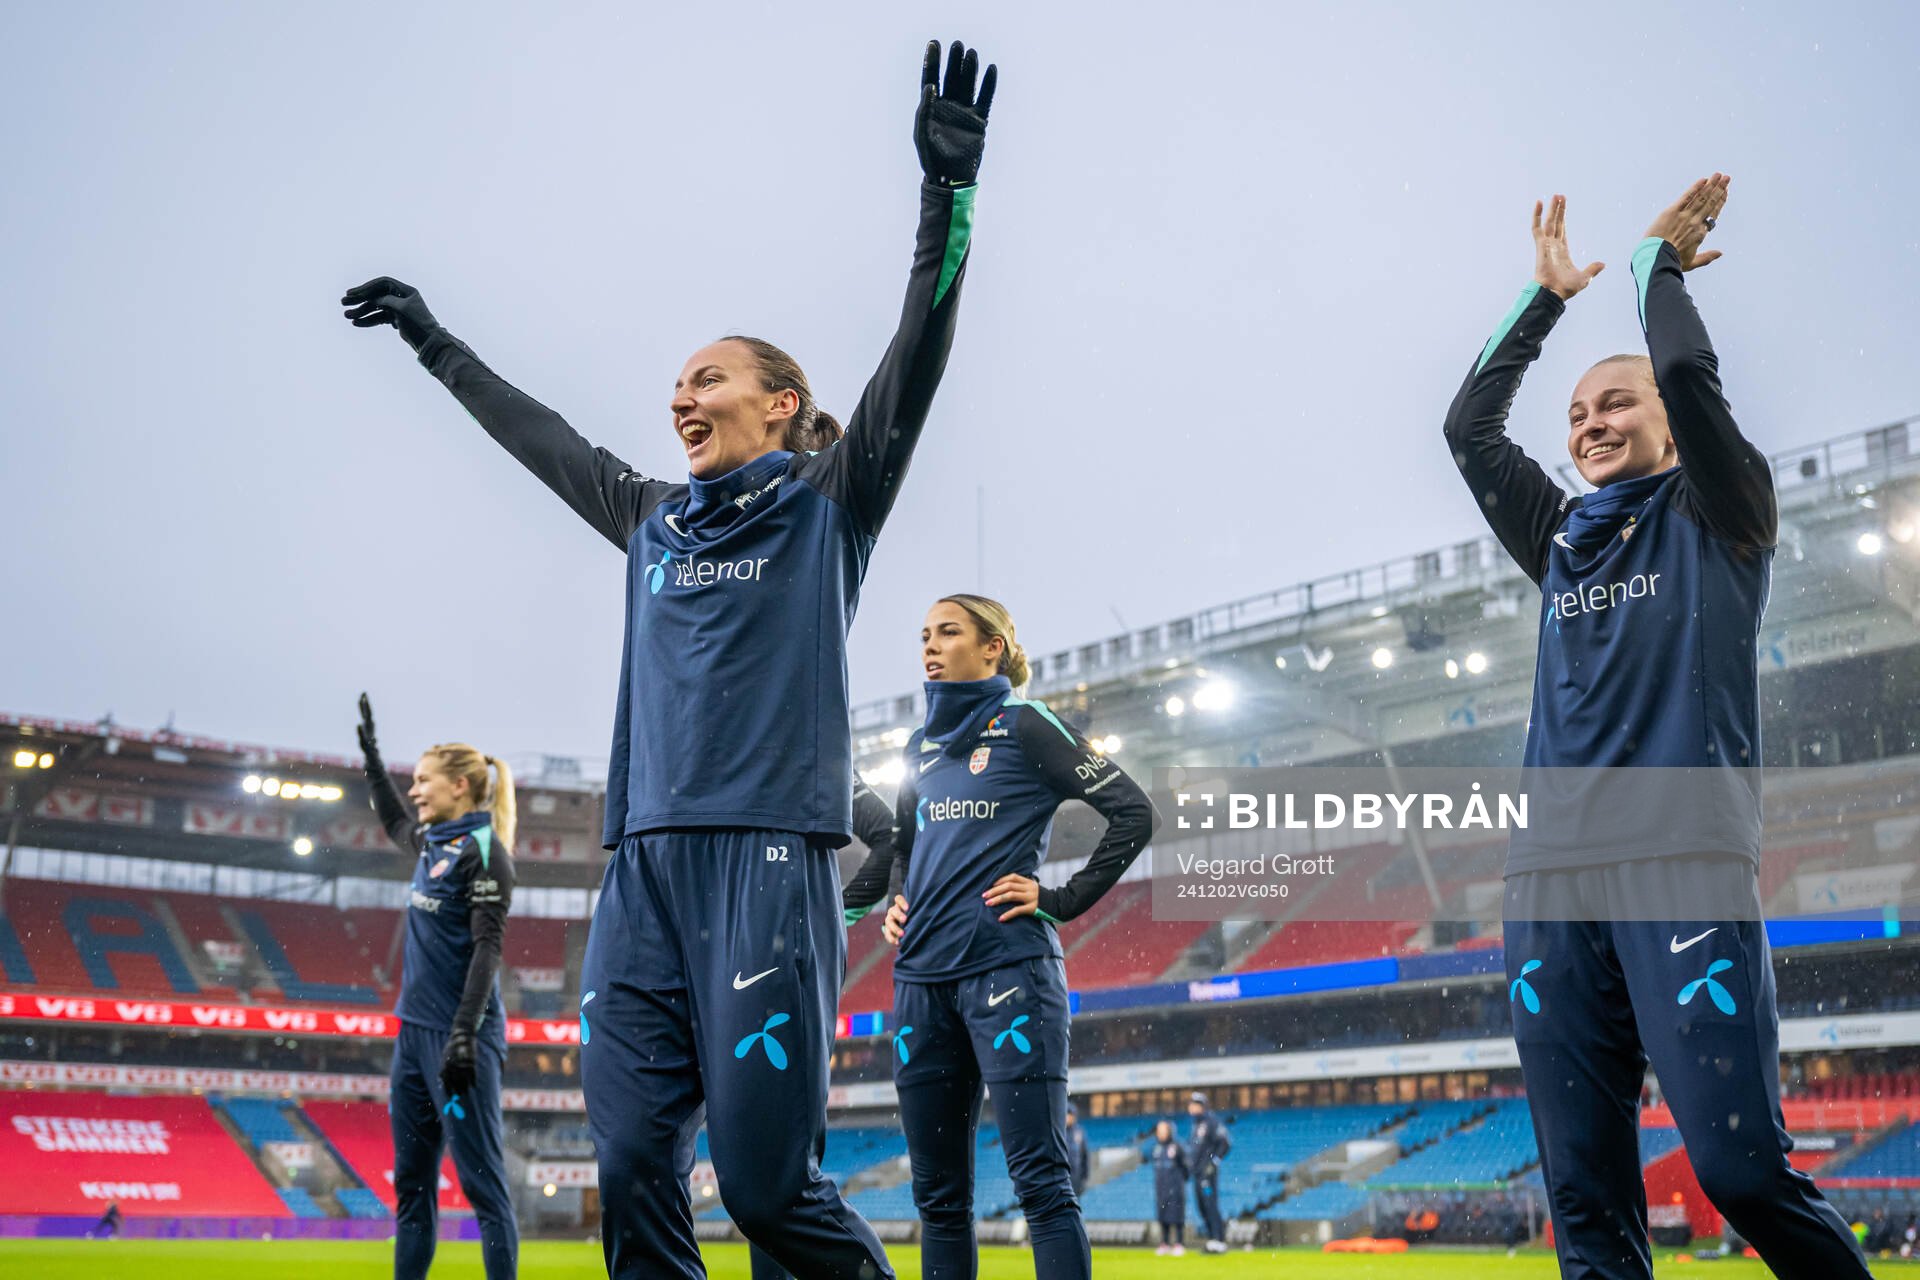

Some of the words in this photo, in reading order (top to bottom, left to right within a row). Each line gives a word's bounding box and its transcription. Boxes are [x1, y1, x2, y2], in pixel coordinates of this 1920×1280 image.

[675, 555, 769, 586] telenor
[1553, 574, 1661, 619] telenor
[1075, 754, 1107, 780] DNB
[929, 796, 1000, 822] telenor
[766, 846, 789, 861] D2
[35, 997, 96, 1018] VG
[115, 1002, 173, 1023] VG
[191, 1006, 247, 1027] VG
[264, 1010, 318, 1031] VG
[334, 1014, 387, 1034] VG
